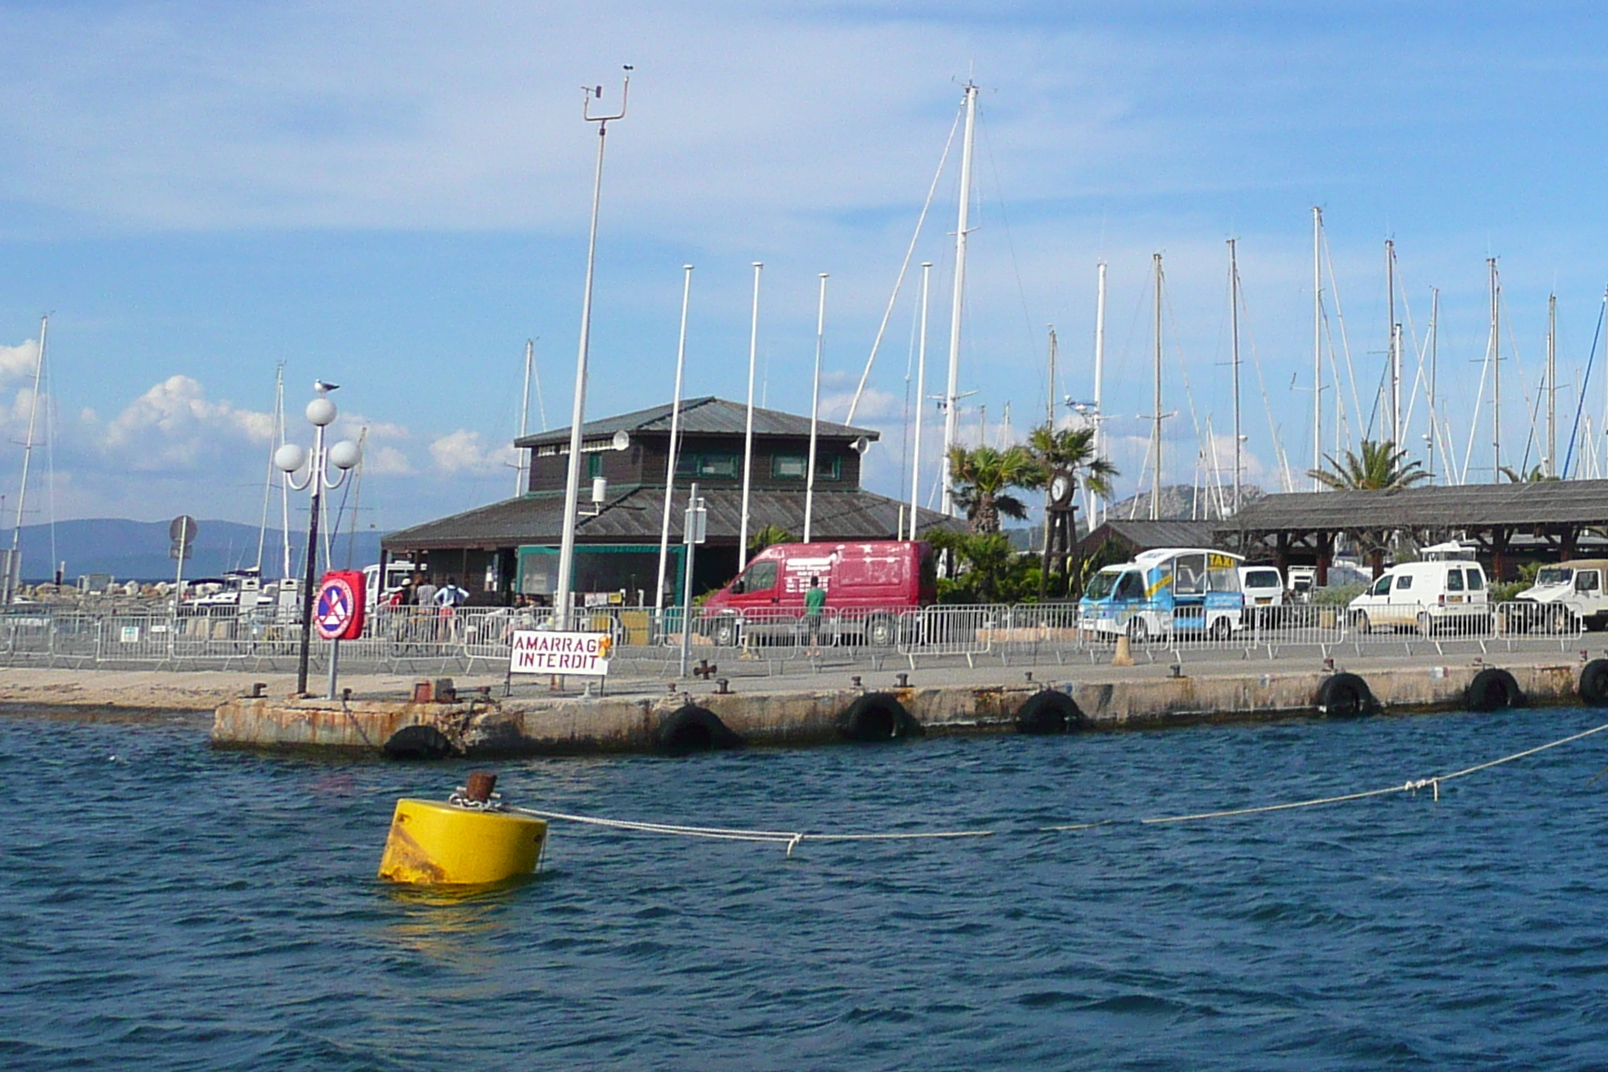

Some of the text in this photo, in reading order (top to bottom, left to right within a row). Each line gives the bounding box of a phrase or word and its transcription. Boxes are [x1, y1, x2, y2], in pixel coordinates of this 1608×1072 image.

[1209, 553, 1234, 569] TAXI
[514, 636, 600, 653] AMARRAG
[519, 652, 600, 670] INTERDIT
